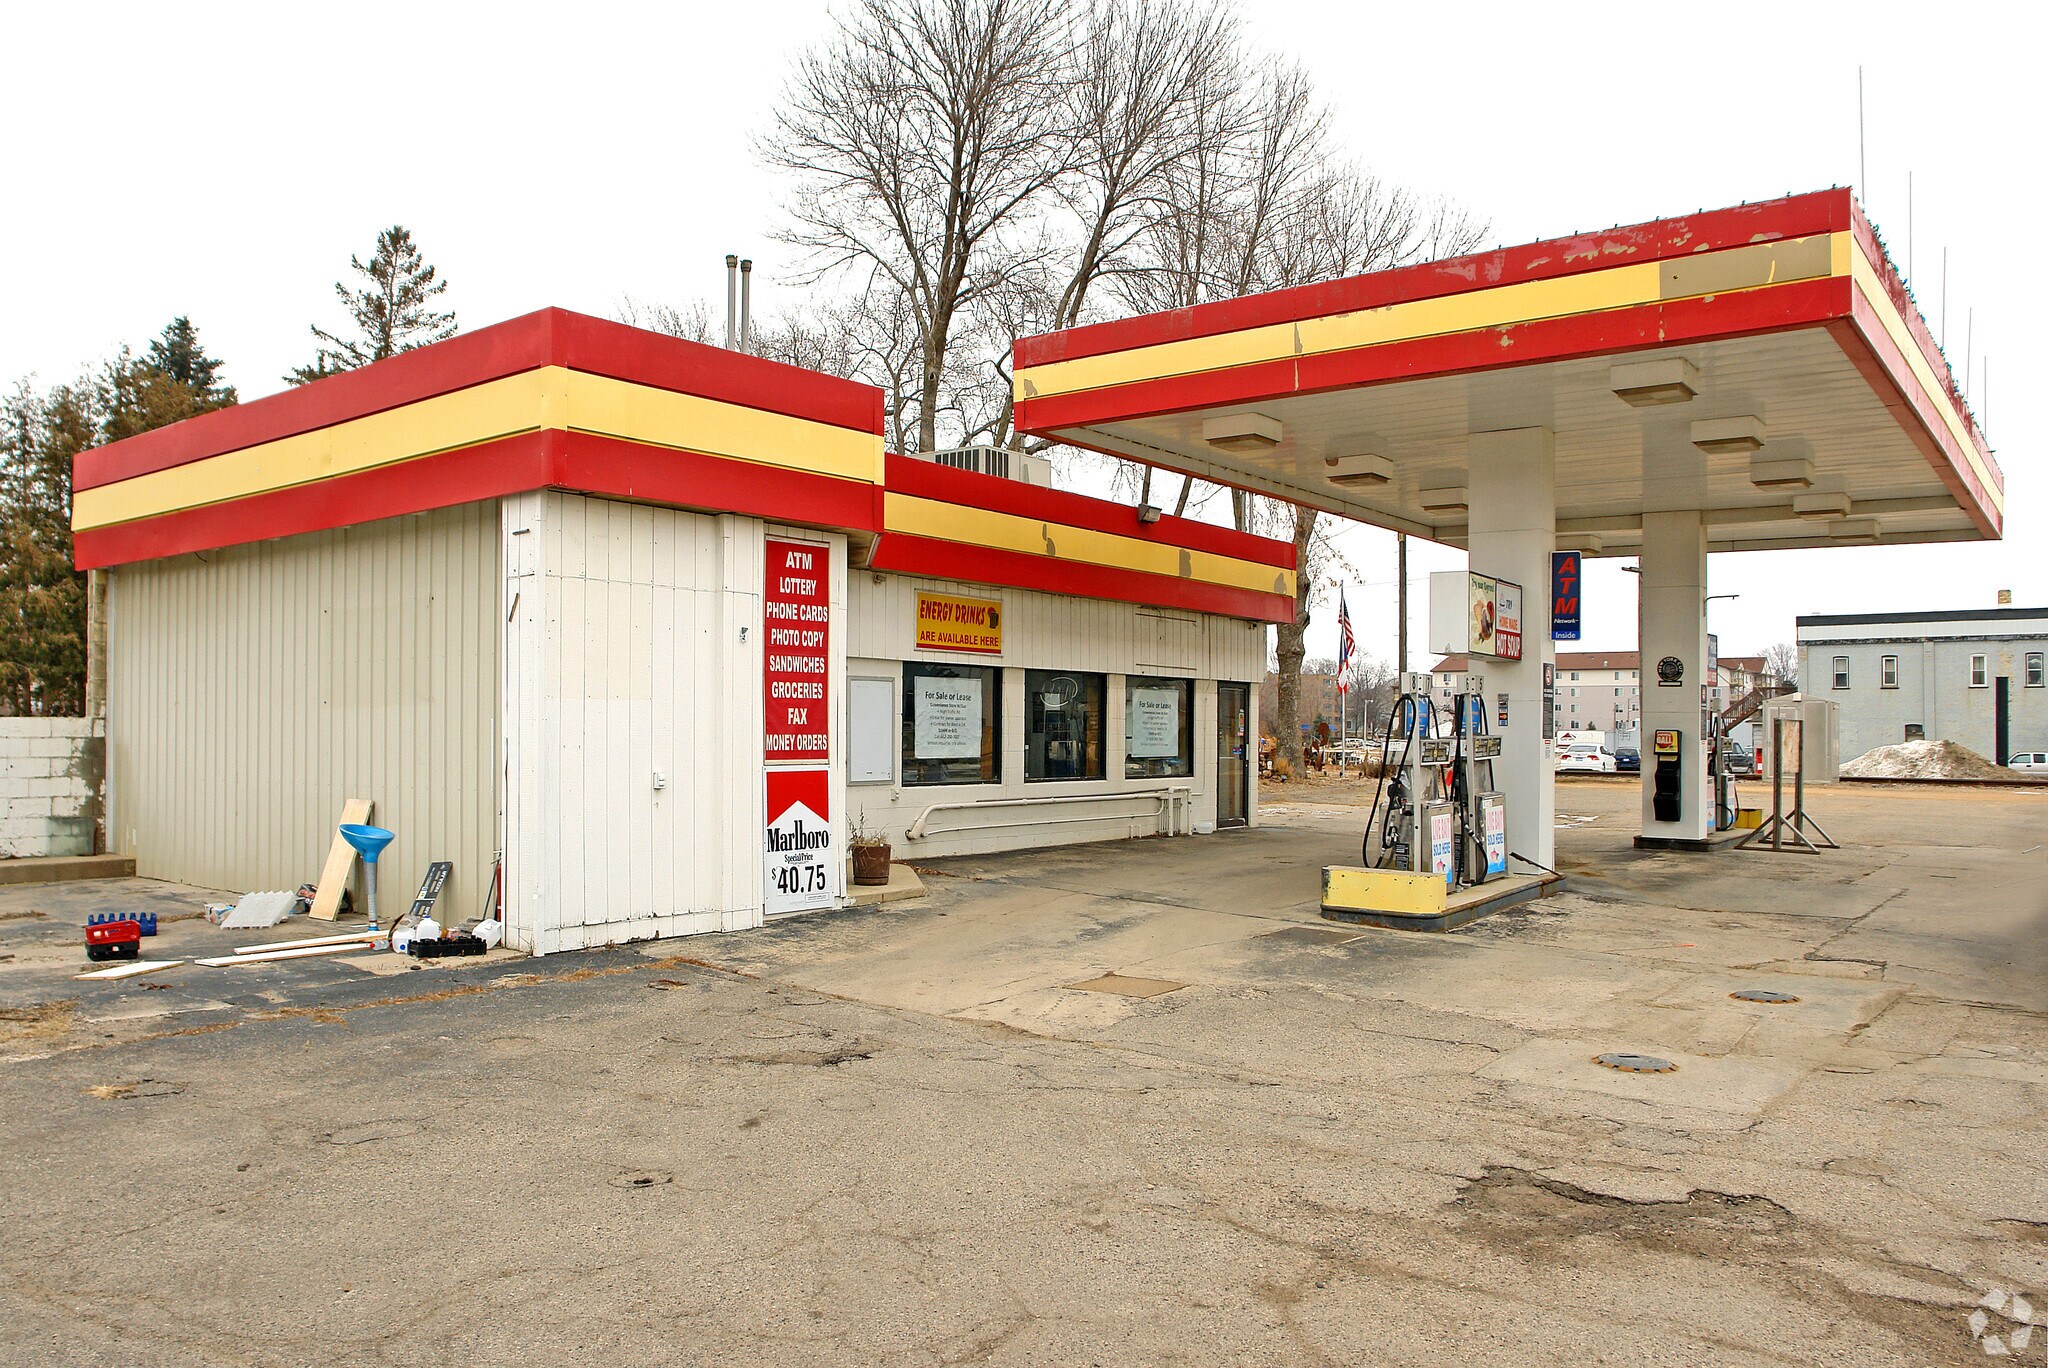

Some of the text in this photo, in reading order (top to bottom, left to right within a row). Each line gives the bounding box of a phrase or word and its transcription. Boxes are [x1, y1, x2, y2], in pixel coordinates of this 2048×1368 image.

[786, 551, 812, 570] ATM
[780, 576, 816, 596] LOTTERY
[1554, 557, 1577, 614] ATM
[766, 602, 828, 622] PHONE CARDS
[920, 600, 985, 626] ENERGY DRINKS
[771, 628, 824, 647] PHOTO COPY
[920, 631, 998, 647] ARE AVAILABLE HERE
[1496, 632, 1520, 657] HOT SOUP
[769, 655, 825, 673] SANDWICHES
[771, 681, 823, 699] GROCERIES
[1412, 675, 1416, 690] 8
[925, 691, 935, 699] For
[936, 692, 948, 700] Sale
[957, 693, 972, 701] Lease
[1146, 701, 1155, 709] Sale
[787, 708, 808, 725] FAX
[766, 734, 828, 750] MONEY ORDERS
[767, 820, 829, 852] Marlboro
[1442, 841, 1450, 855] HERE
[784, 852, 814, 864] Special Price
